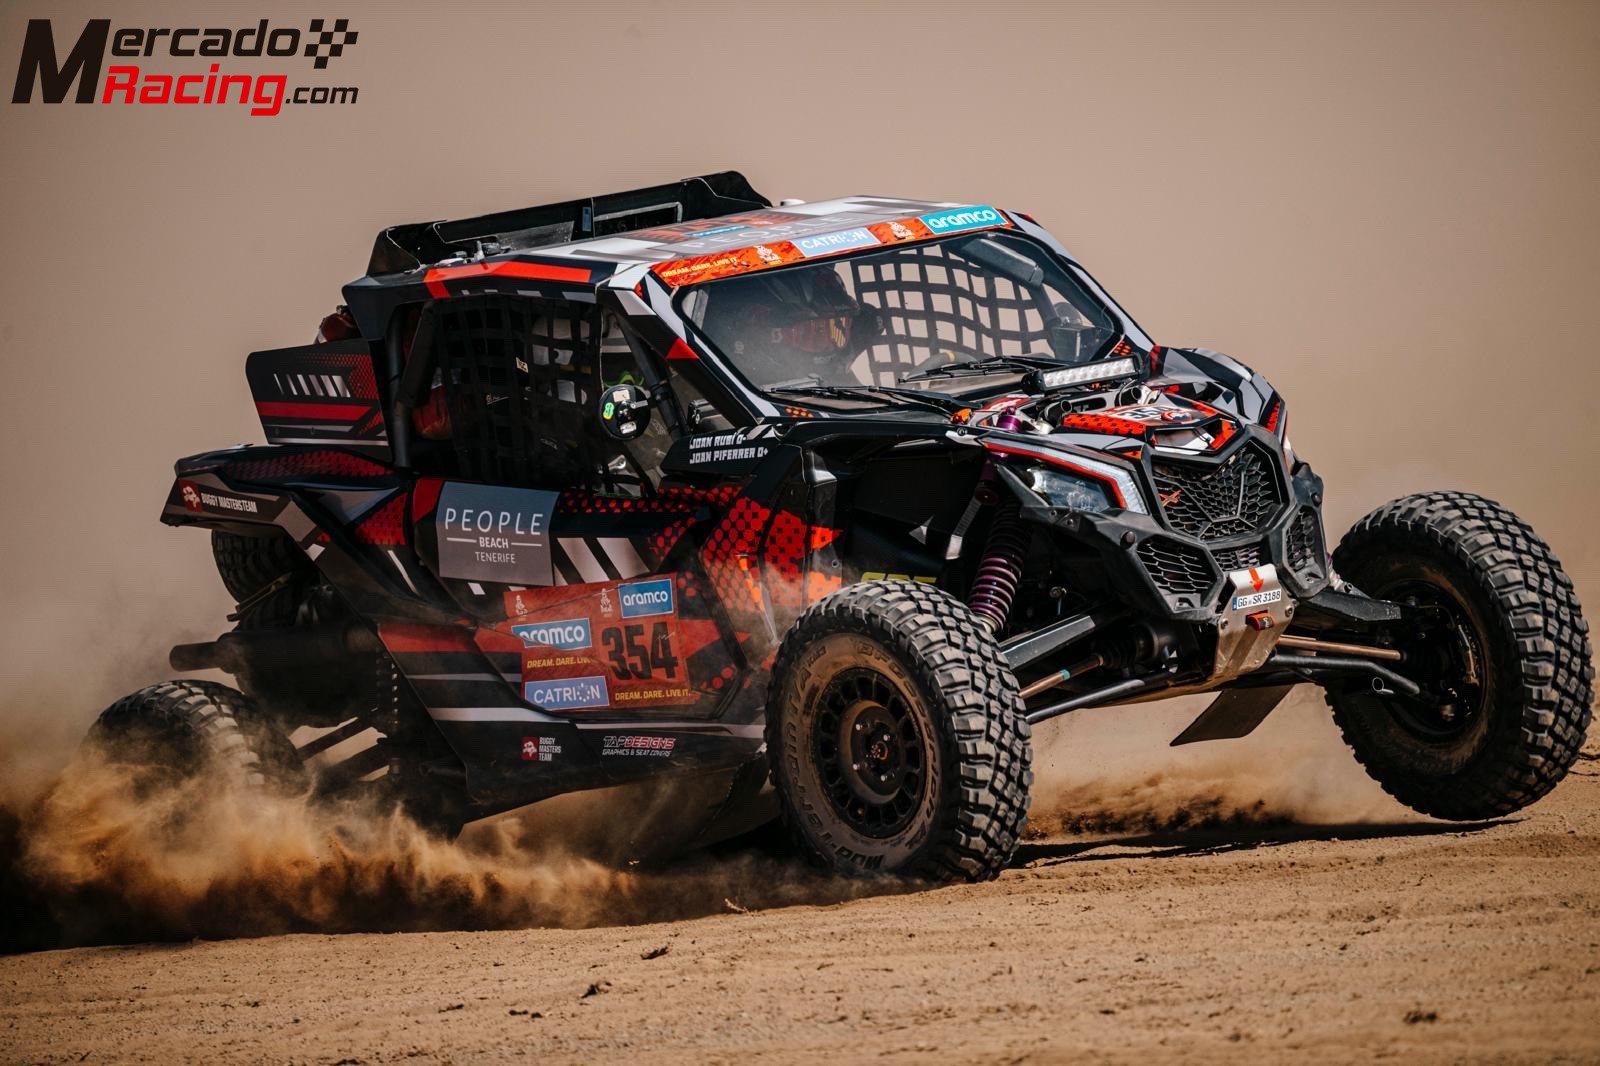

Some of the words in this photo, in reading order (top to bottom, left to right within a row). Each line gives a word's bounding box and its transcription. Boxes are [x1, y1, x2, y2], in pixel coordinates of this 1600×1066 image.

[928, 209, 997, 229] aramco
[689, 436, 713, 450] JOAN
[689, 451, 712, 464] JOAN
[713, 447, 756, 461] PIFERRER
[444, 508, 543, 536] PEOPLE
[479, 536, 509, 549] BEACH
[475, 551, 516, 564] TENERIFE
[623, 590, 668, 606] aramco
[1252, 594, 1262, 604] SR
[601, 621, 679, 681] 354
[615, 691, 642, 701] DREAM.
[643, 690, 665, 699] DARE.
[666, 689, 682, 697] LIVE
[539, 736, 556, 745] BUGGY
[539, 745, 562, 754] MASTERS
[602, 749, 630, 757] GRAPHICS
[538, 753, 552, 762] TEAM
